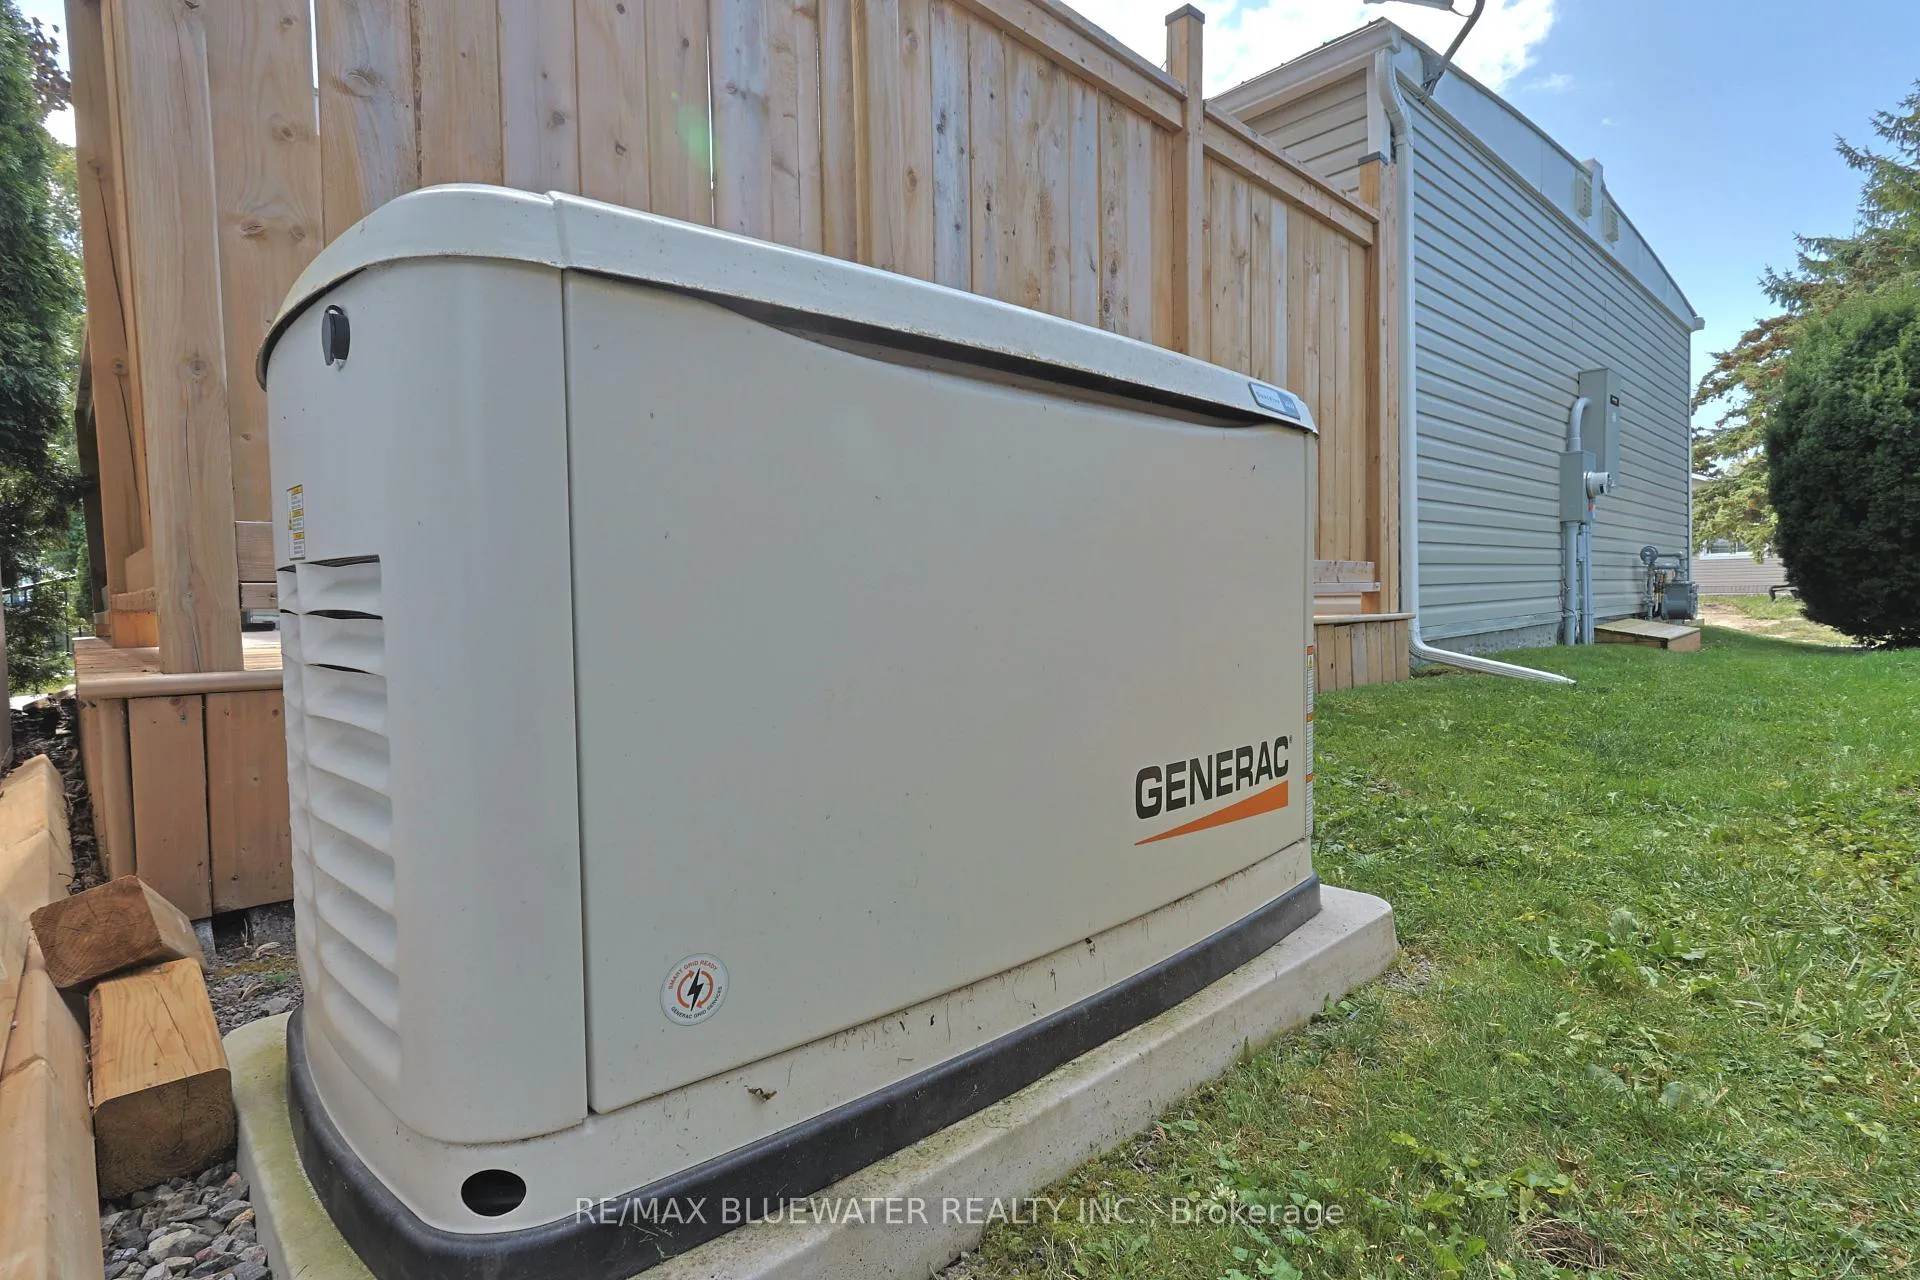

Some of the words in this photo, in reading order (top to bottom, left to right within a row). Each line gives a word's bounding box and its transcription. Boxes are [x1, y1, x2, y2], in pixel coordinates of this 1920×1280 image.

[1135, 735, 1289, 820] GENERAC
[700, 959, 718, 971] READY
[671, 1006, 693, 1019] GENERAC
